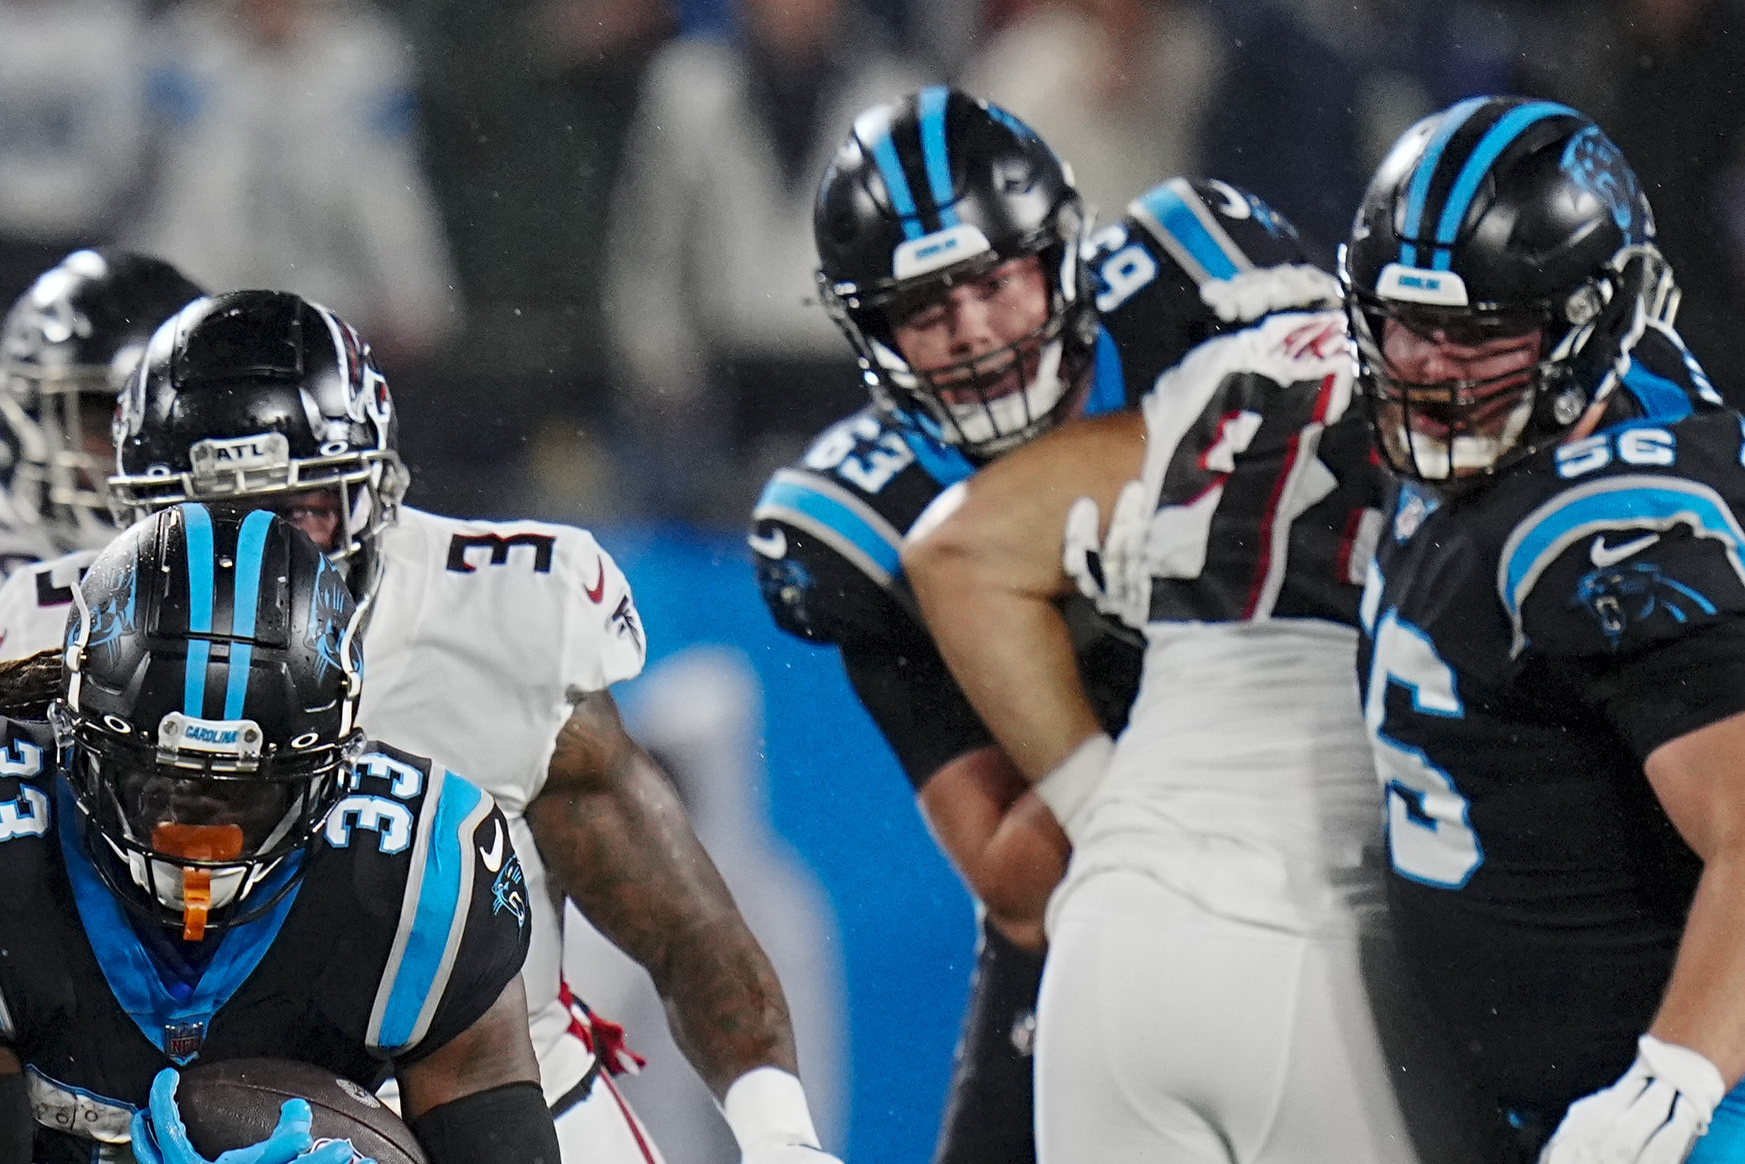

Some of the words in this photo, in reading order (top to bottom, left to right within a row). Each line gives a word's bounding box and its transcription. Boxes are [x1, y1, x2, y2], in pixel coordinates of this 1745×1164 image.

[215, 443, 265, 461] ATL
[1554, 427, 1678, 479] 56
[445, 531, 557, 575] 3
[185, 724, 240, 745] CAROLINA
[1359, 557, 1485, 890] 6
[322, 751, 424, 856] 33
